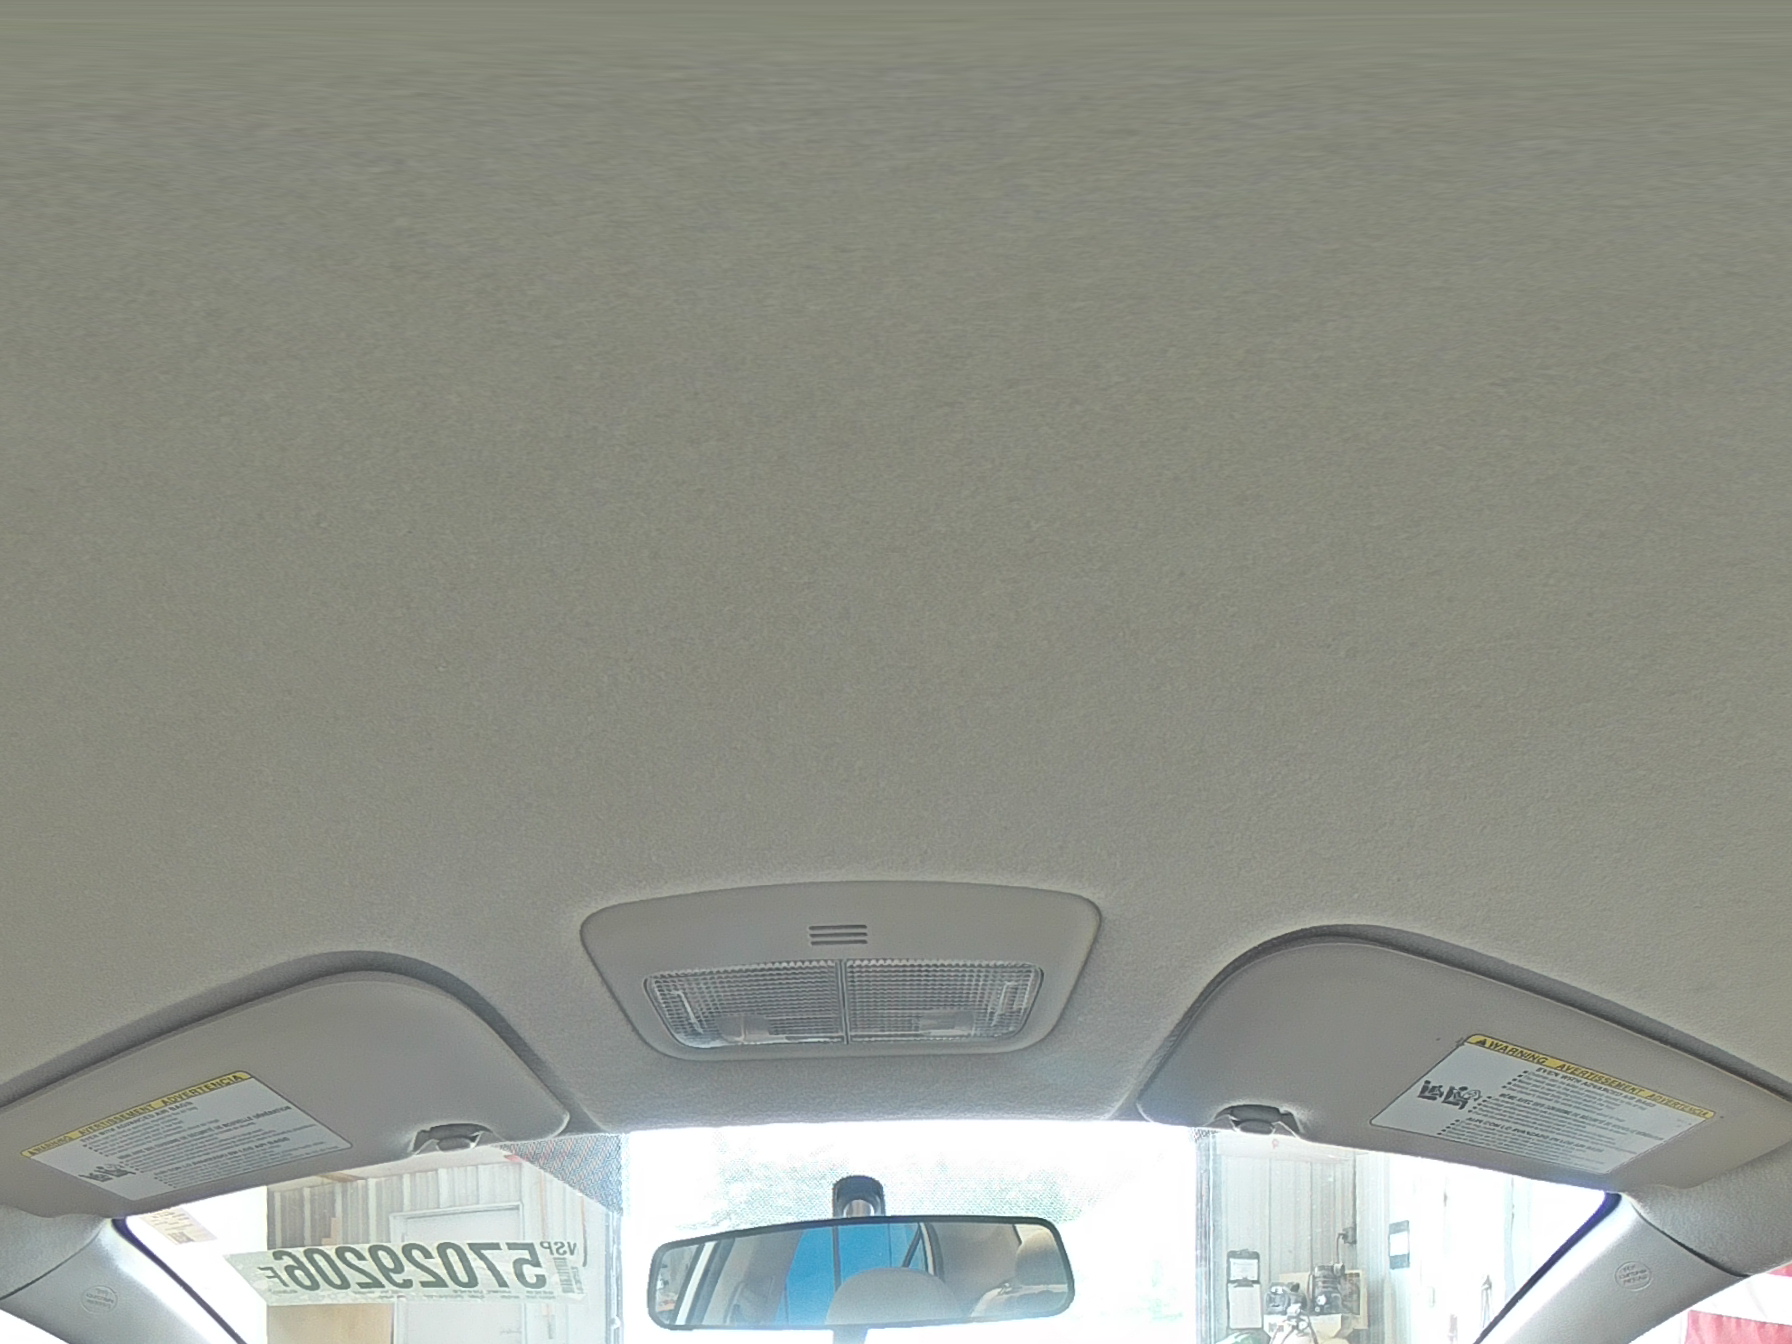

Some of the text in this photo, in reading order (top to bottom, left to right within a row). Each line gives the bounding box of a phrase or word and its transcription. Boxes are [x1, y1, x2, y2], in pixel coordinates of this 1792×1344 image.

[161, 1074, 242, 1106] ADVERTENCIA
[1488, 1040, 1548, 1065] WARNING
[1556, 1062, 1645, 1097] AVERTISSEMENT
